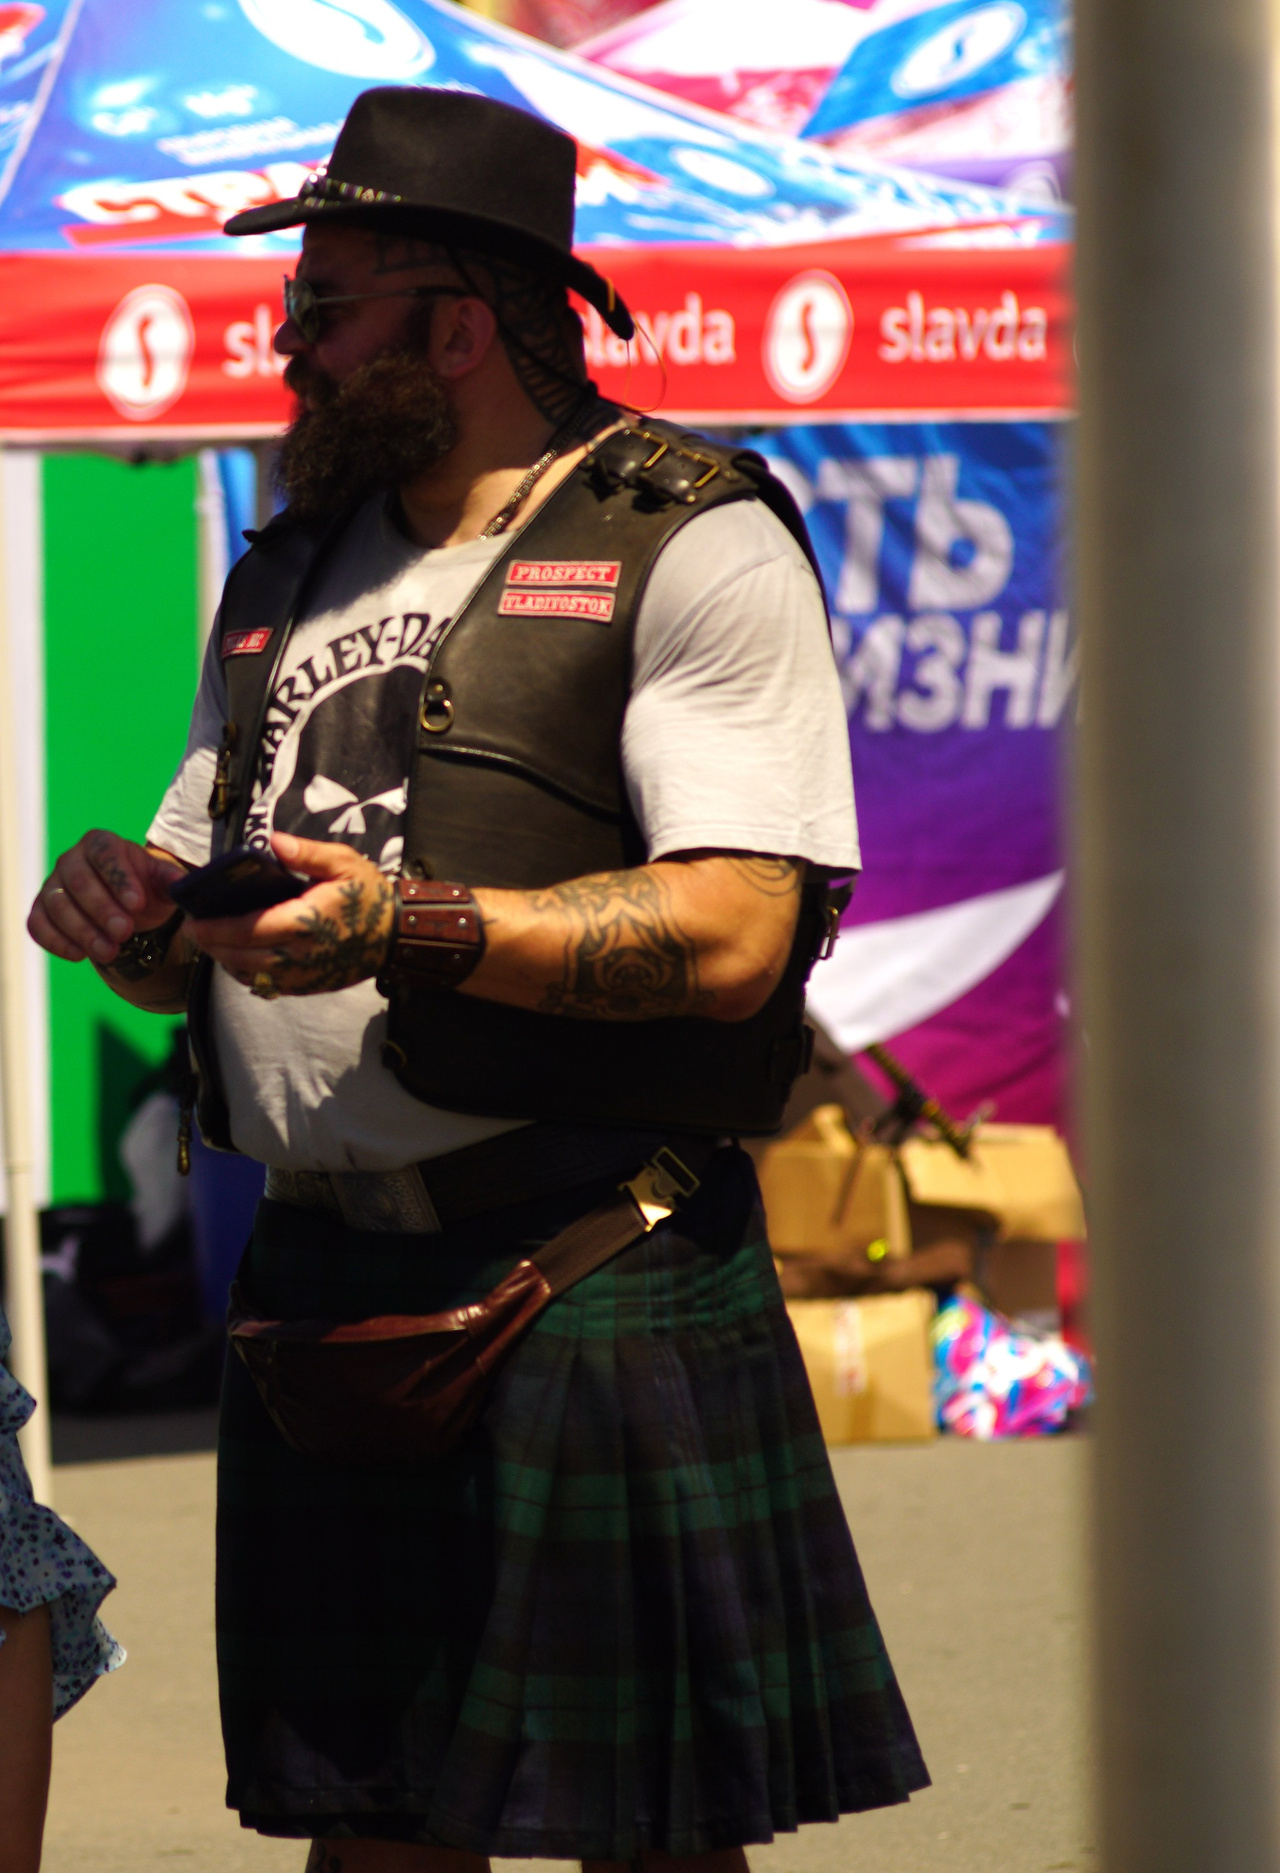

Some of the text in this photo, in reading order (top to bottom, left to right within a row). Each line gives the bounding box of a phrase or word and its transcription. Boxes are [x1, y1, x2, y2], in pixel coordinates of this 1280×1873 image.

[877, 289, 1048, 364] slavda
[516, 565, 612, 581] PROSPECT
[505, 594, 611, 615] VLADIVOSTOK
